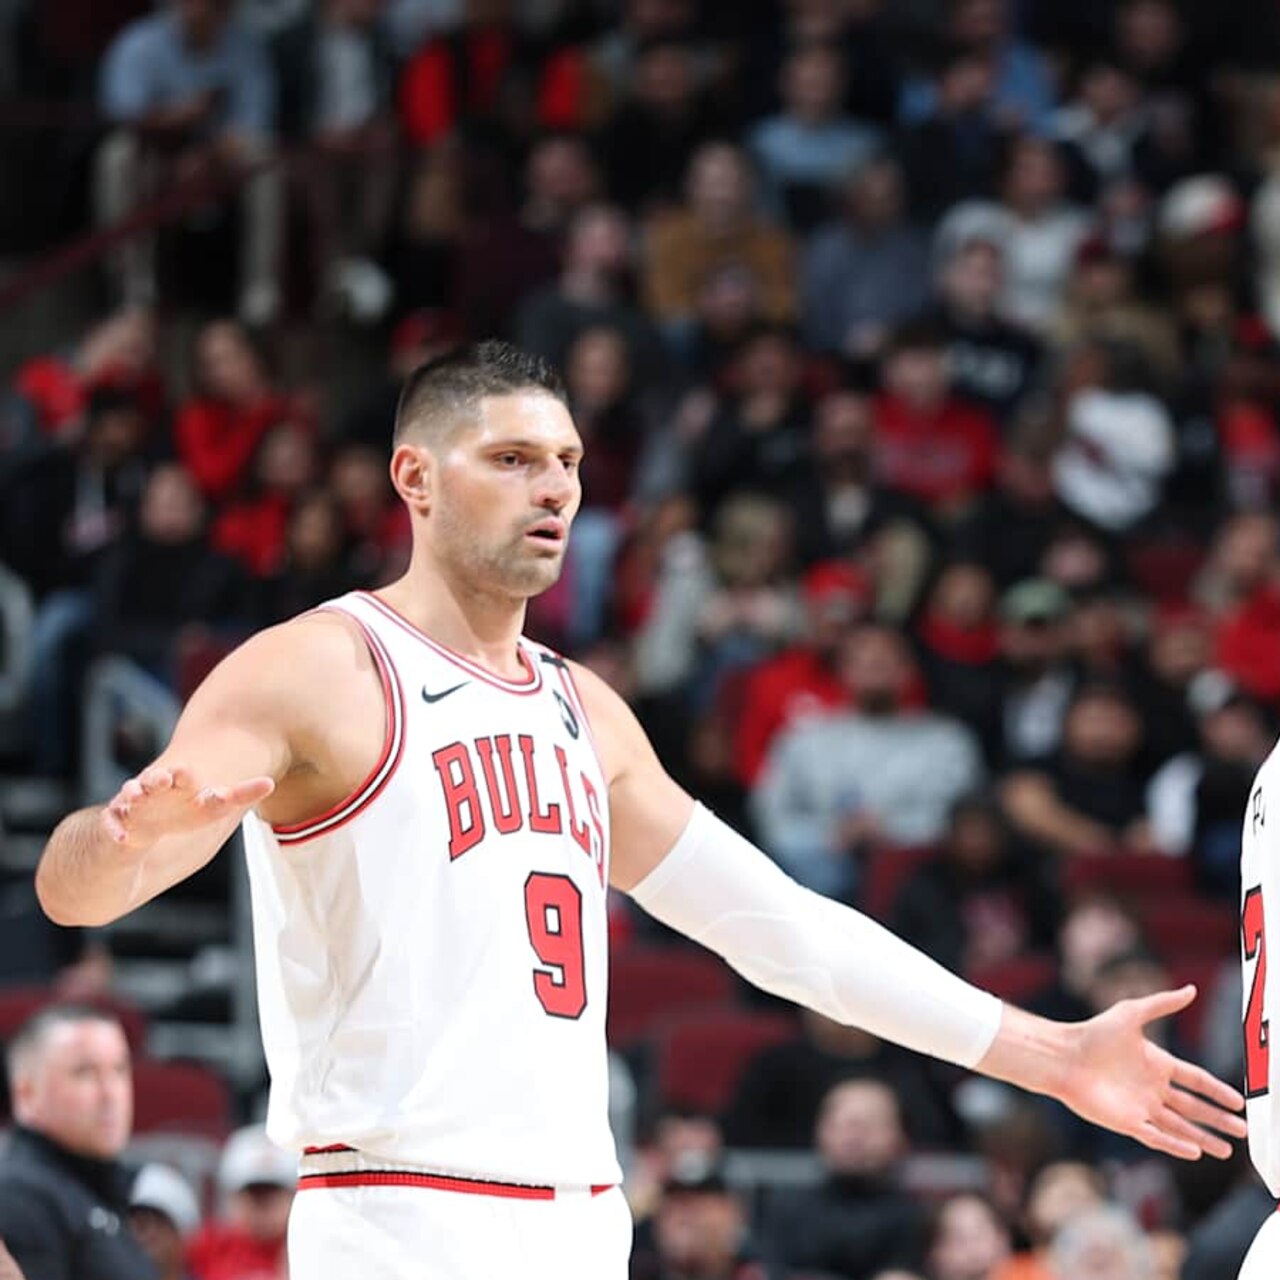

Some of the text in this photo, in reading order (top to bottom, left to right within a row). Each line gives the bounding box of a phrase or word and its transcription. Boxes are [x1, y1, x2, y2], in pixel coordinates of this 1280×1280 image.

[431, 733, 604, 890] BULLS
[523, 870, 588, 1021] 9
[1241, 883, 1270, 1100] 2
